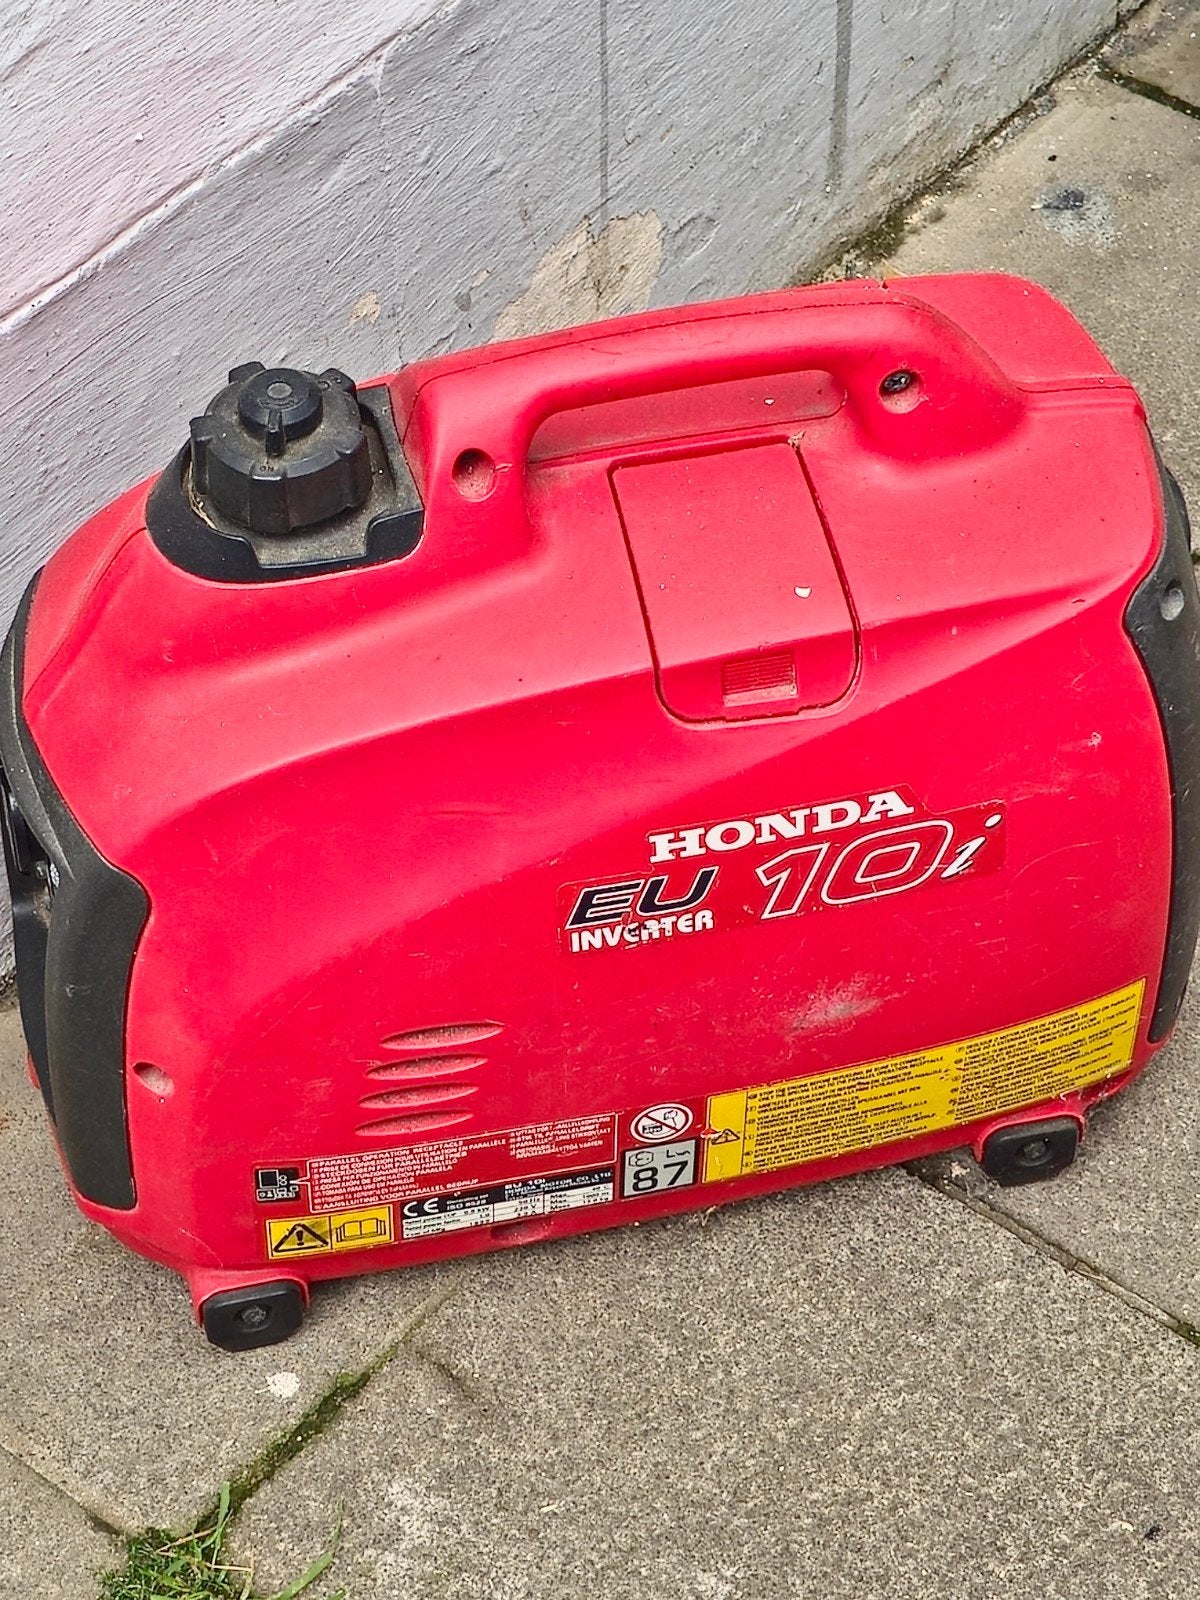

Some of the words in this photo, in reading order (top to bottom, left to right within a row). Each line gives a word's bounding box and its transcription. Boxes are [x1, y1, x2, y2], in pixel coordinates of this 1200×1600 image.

[648, 789, 914, 864] HONDA
[563, 865, 719, 930] EU
[319, 1157, 360, 1167] PARALLEL
[362, 1149, 409, 1161] OPERATION
[413, 1141, 462, 1153] RECEPTACLE
[632, 1160, 688, 1192] 87
[381, 1191, 405, 1200] VOOR
